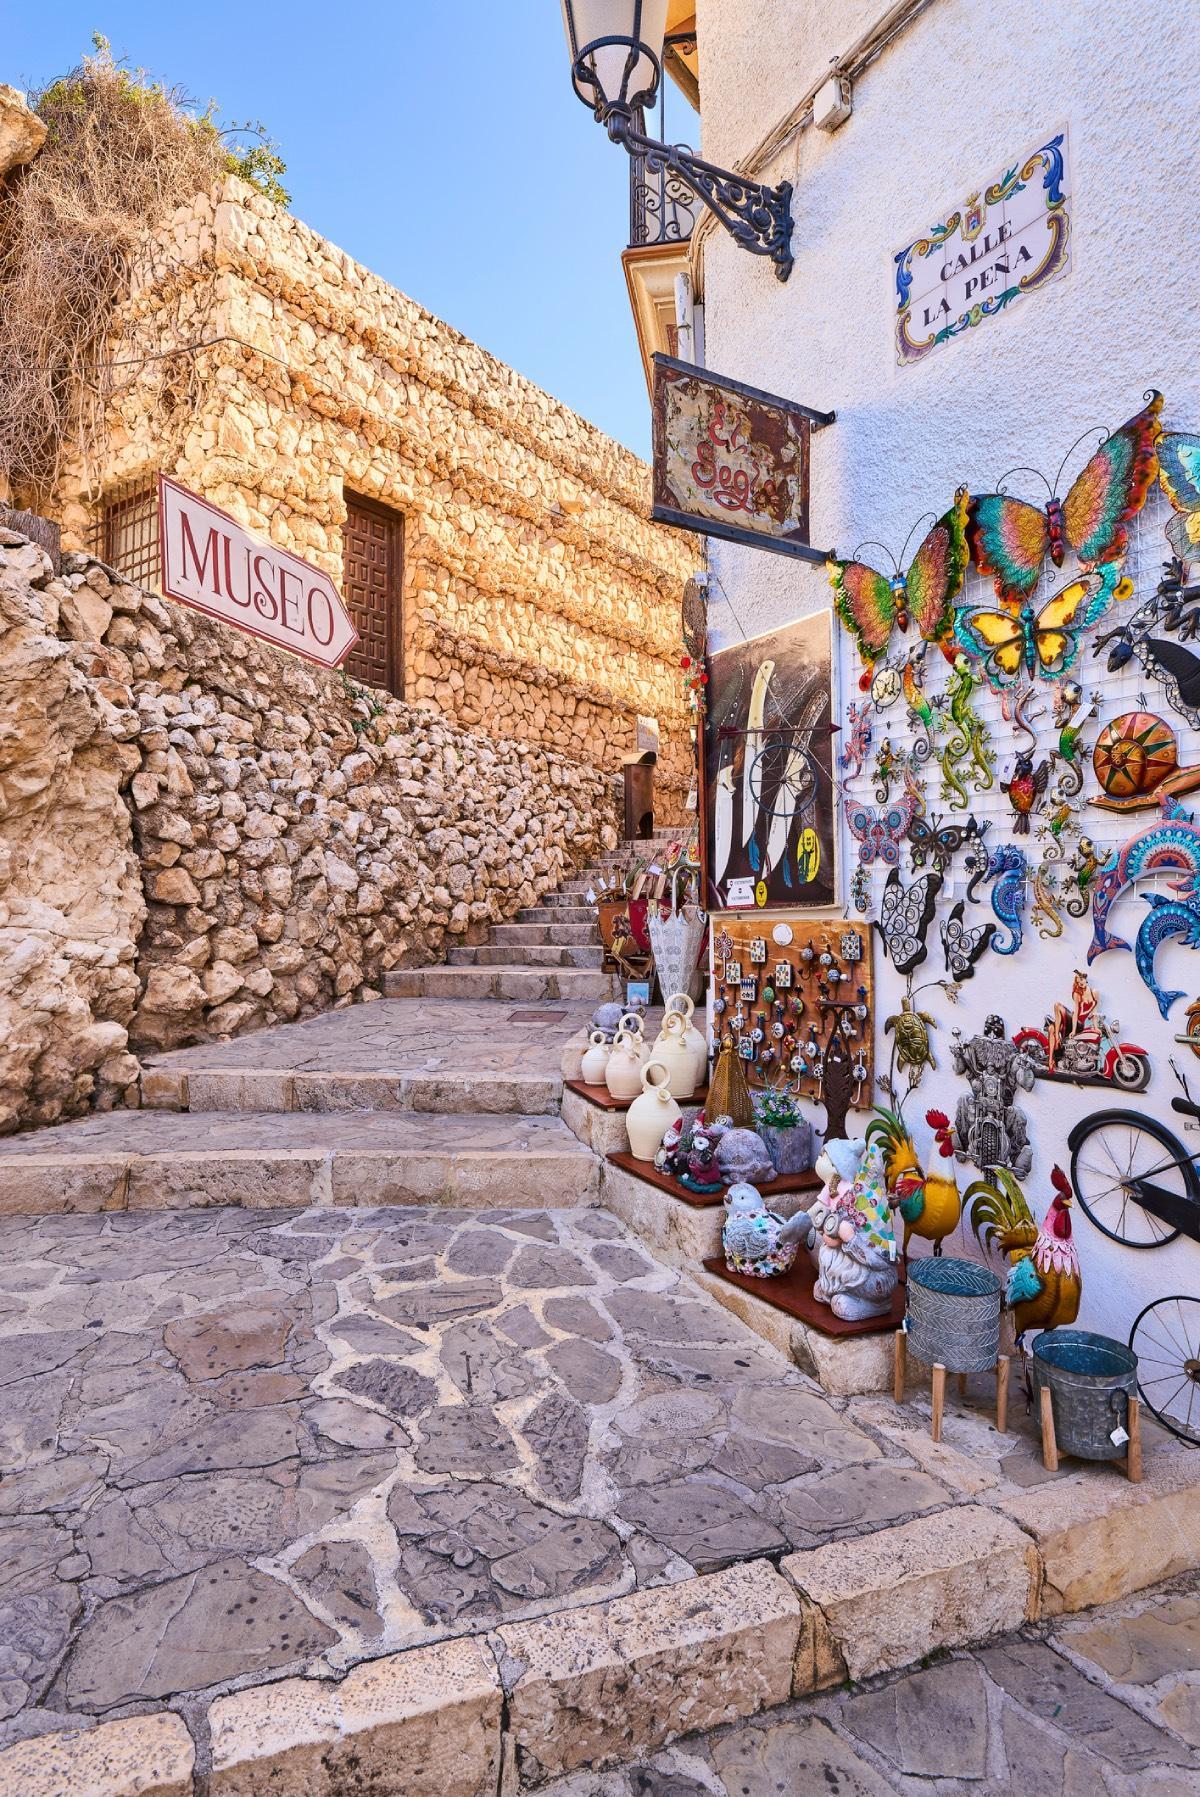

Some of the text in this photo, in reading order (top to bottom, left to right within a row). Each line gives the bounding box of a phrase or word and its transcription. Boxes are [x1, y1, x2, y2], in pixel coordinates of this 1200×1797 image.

[923, 245, 1033, 327] LA PEÑA
[940, 220, 1012, 282] CALLE
[178, 509, 334, 646] MUSEO
